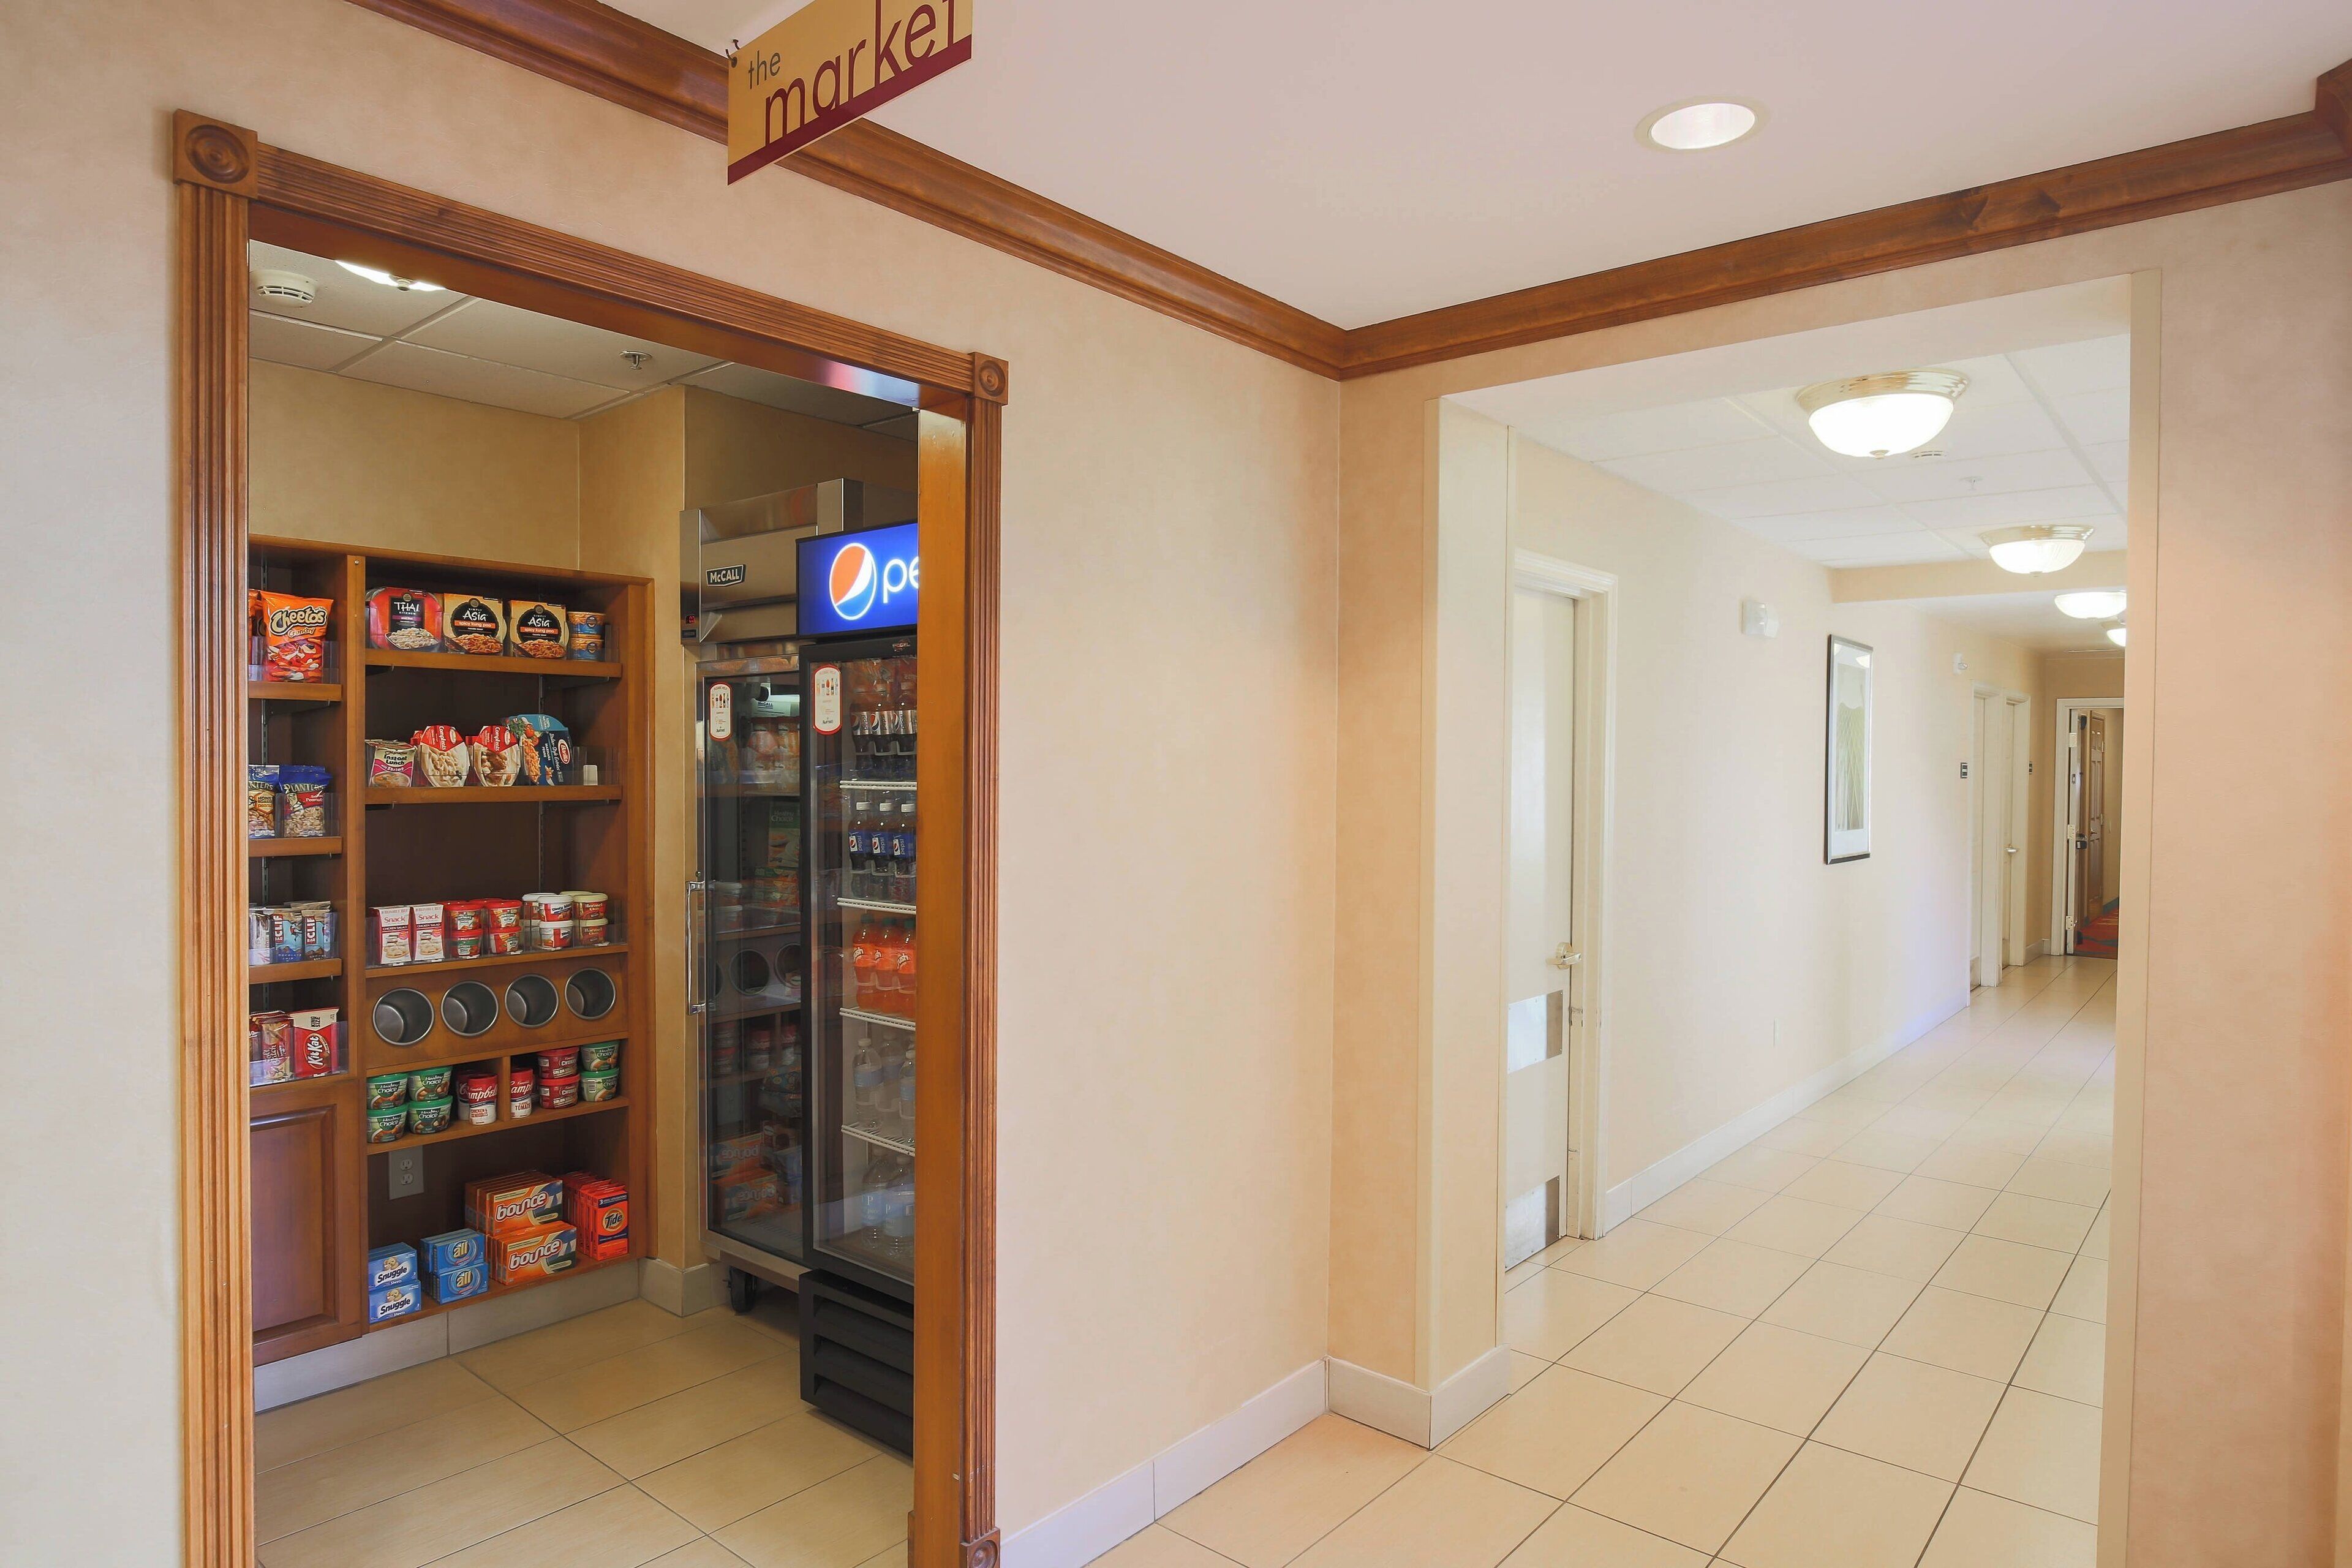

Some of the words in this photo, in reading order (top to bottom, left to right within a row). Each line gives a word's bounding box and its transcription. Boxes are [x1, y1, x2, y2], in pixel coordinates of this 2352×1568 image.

[748, 50, 781, 89] the
[710, 568, 740, 583] McCALL
[394, 602, 420, 612] THAI
[462, 610, 487, 622] Asia
[270, 606, 326, 635] Cheetos
[528, 617, 550, 628] Asia
[288, 627, 315, 638] Crunchy
[274, 914, 284, 937] CLIF
[306, 916, 316, 938] CLIF
[496, 1192, 548, 1221] bounce
[605, 1213, 622, 1229] Tide
[453, 1238, 470, 1257] all
[509, 1239, 560, 1270] bounce
[377, 1265, 407, 1284] Snuggle
[456, 1270, 472, 1287] all
[380, 1297, 411, 1315] Snuggle
